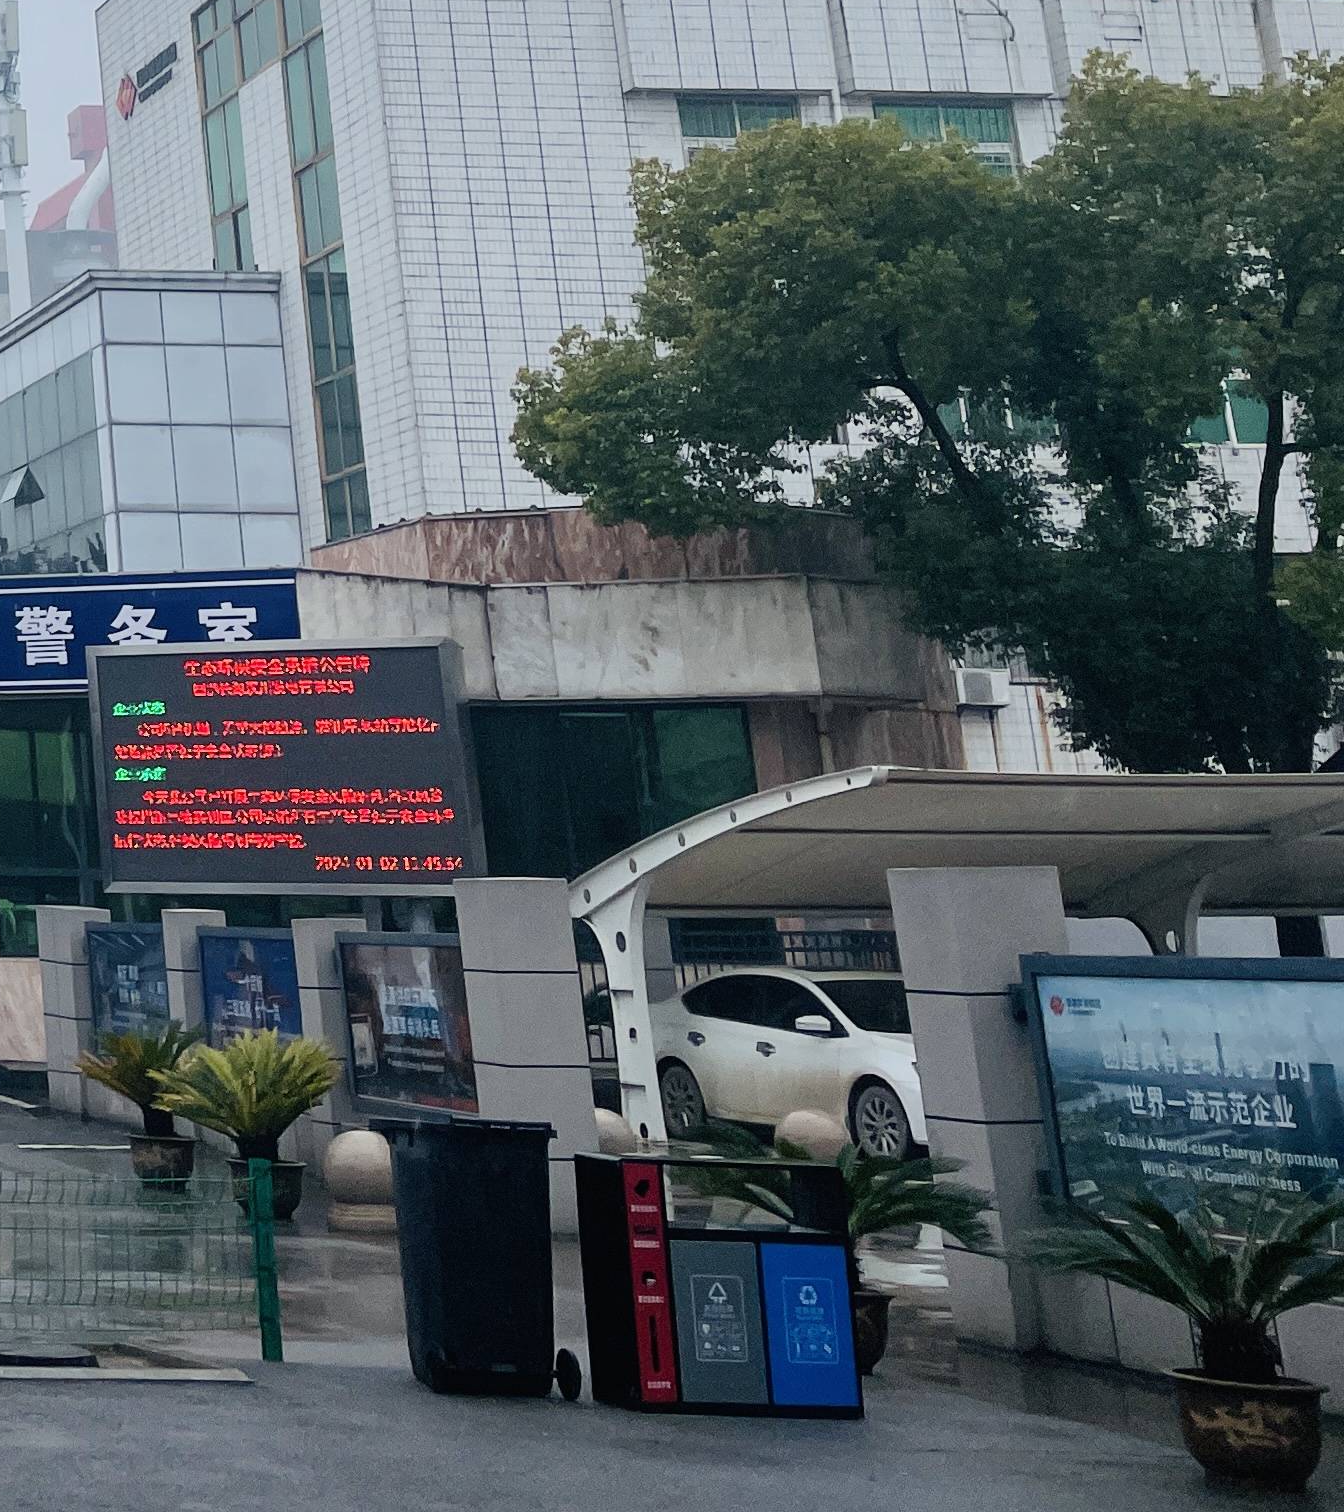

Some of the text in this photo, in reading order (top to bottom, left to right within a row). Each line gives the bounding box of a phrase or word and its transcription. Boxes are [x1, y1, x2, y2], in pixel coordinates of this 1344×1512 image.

[1127, 1083, 1298, 1129] 世界一流示范企业
[1104, 1131, 1117, 1146] To
[1222, 1143, 1263, 1165] Energy
[1265, 1147, 1339, 1170] Corporation
